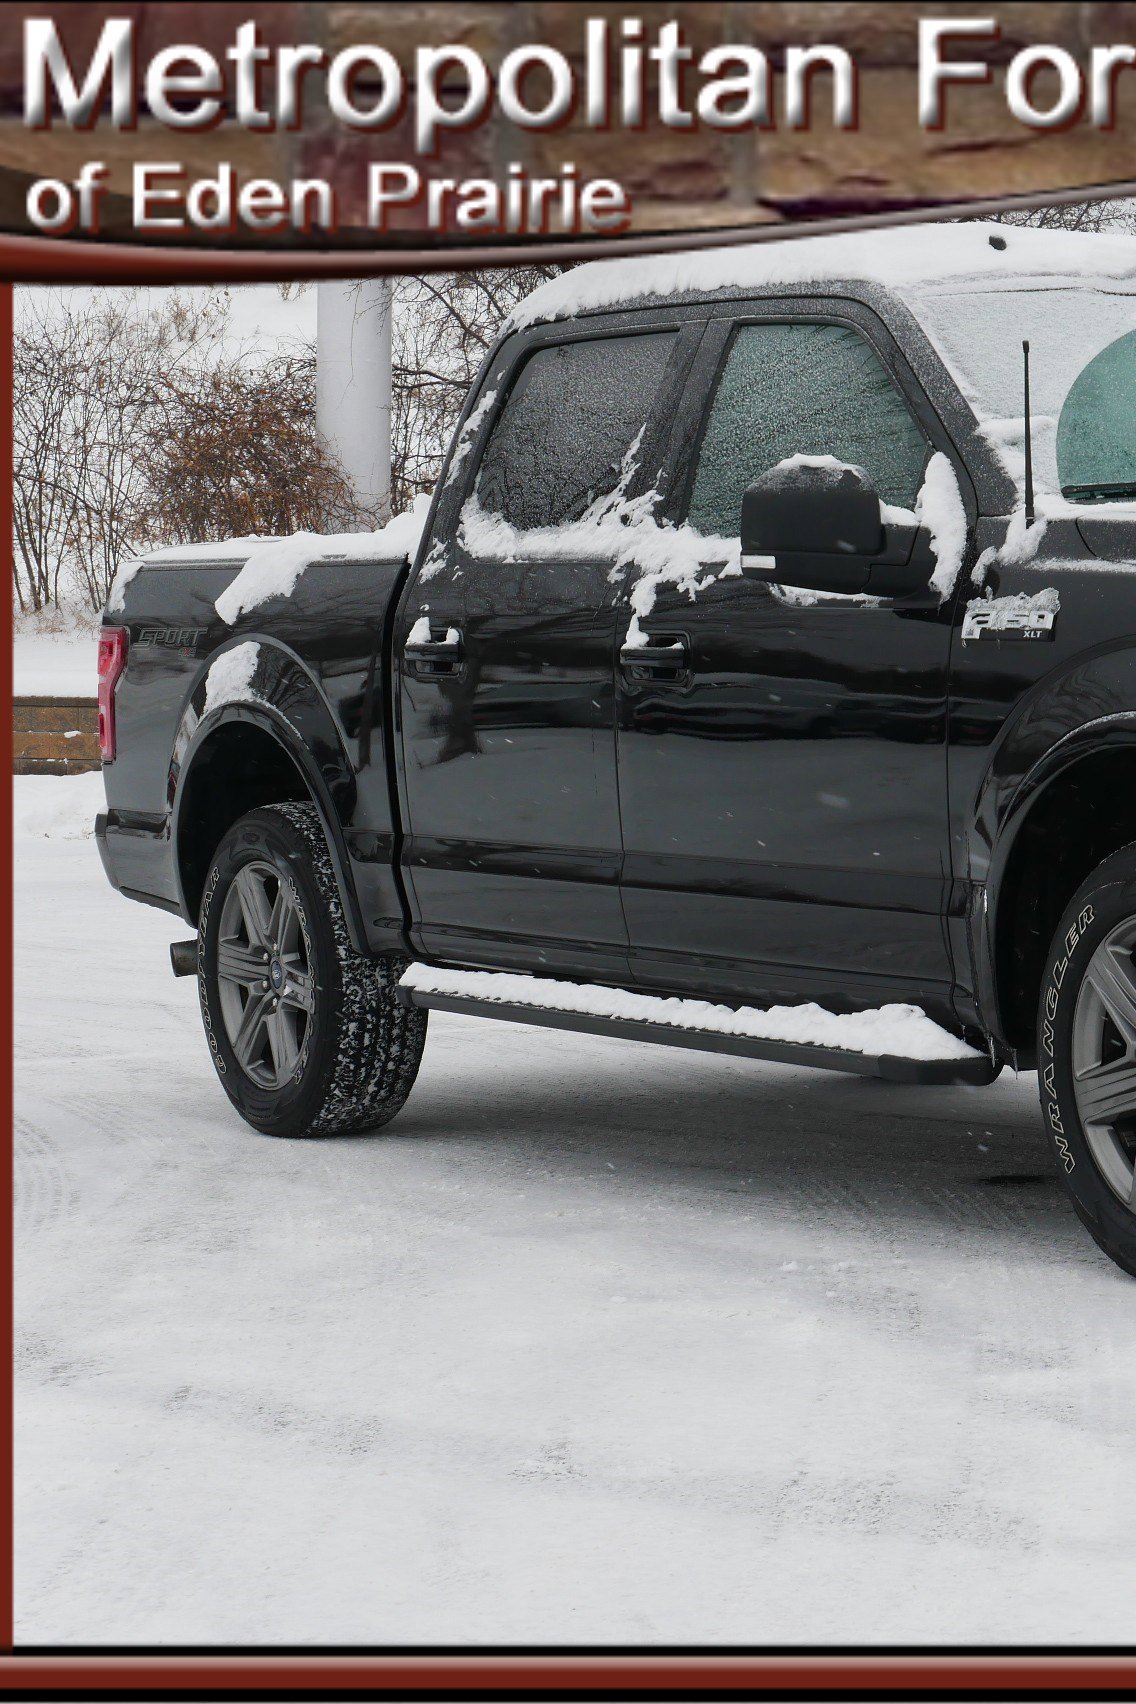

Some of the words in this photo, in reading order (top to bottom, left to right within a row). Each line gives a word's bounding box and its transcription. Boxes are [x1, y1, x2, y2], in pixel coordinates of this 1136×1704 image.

[132, 626, 208, 651] SPORT
[1022, 630, 1043, 639] XLT
[1043, 904, 1095, 1174] WRANGLER
